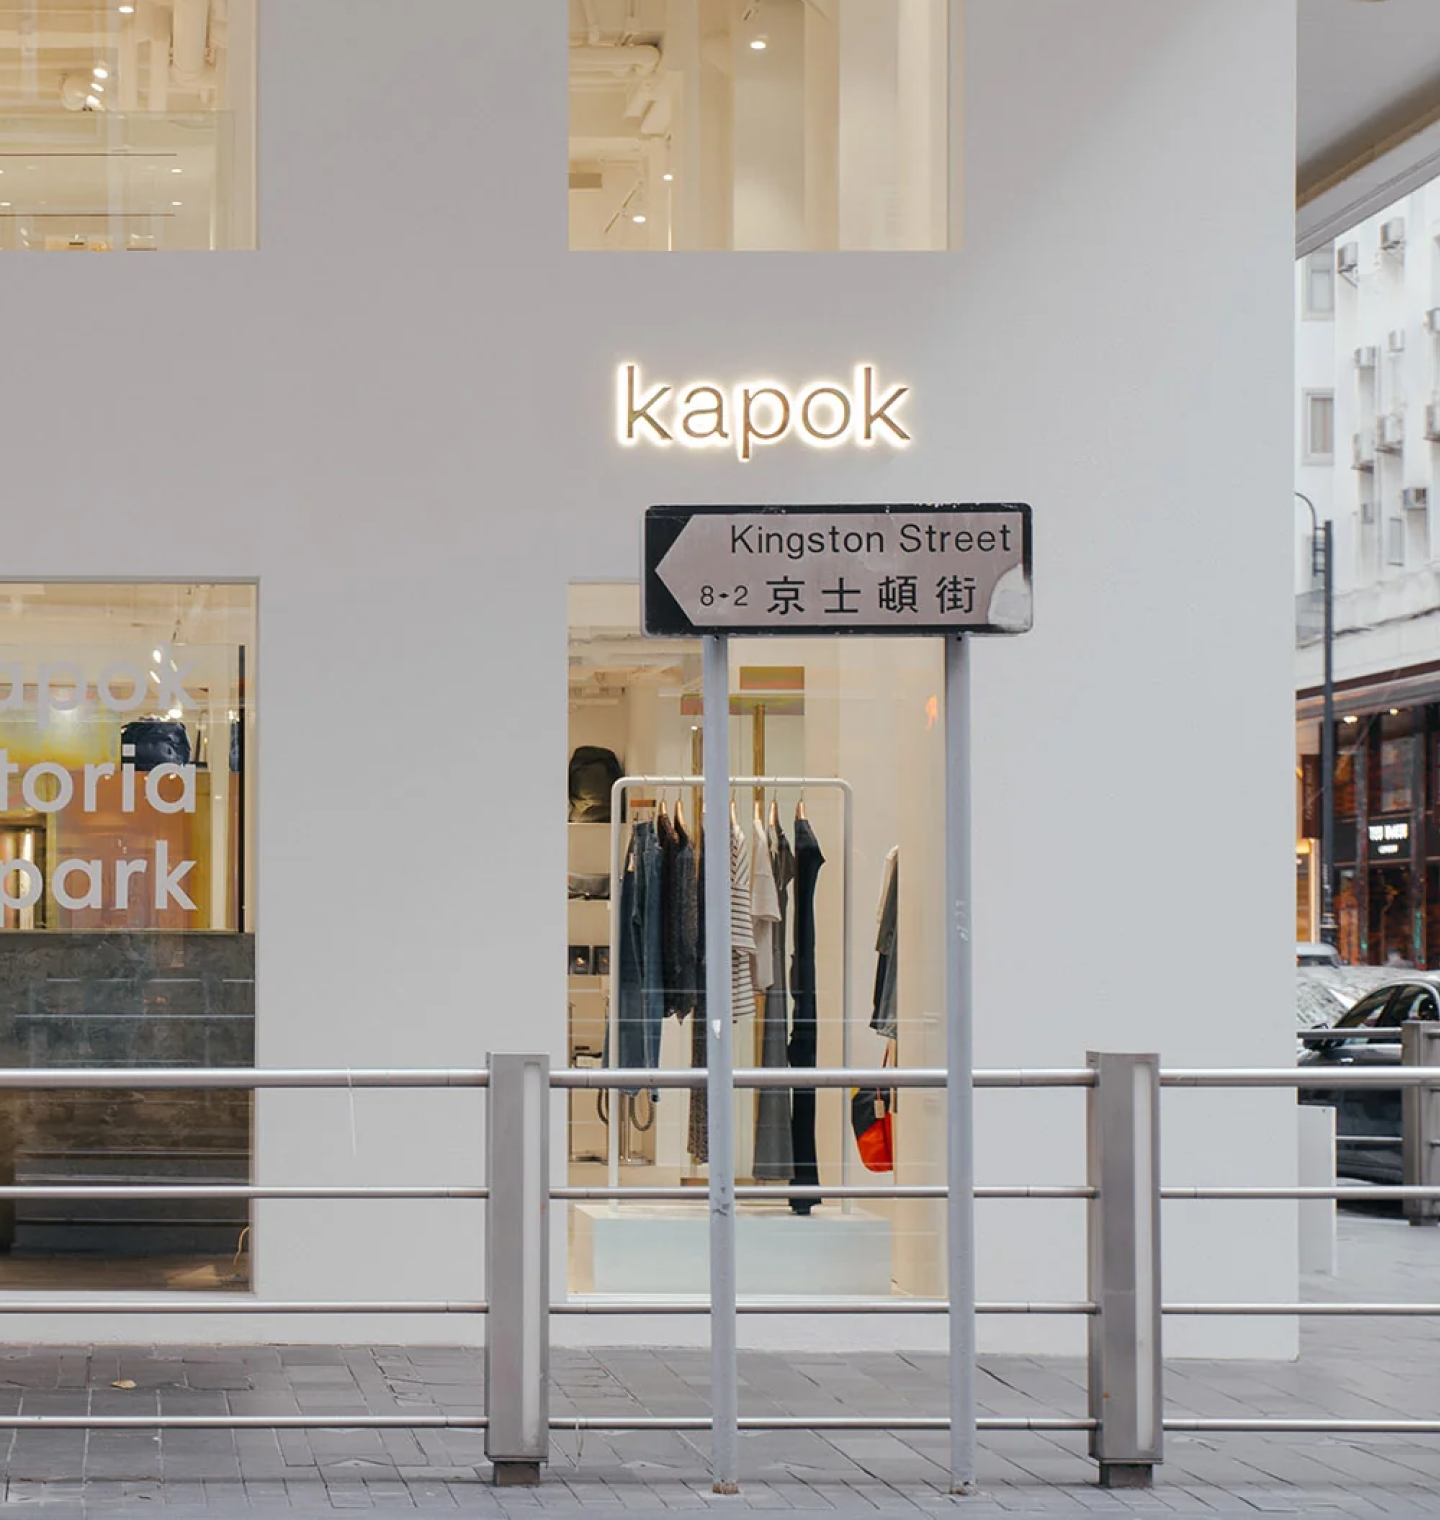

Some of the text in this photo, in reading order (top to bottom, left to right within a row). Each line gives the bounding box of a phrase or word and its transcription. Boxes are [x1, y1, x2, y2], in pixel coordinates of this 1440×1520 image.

[625, 364, 911, 459] kapok
[730, 523, 1012, 560] Kingston Street
[765, 575, 977, 615] 京士頓街
